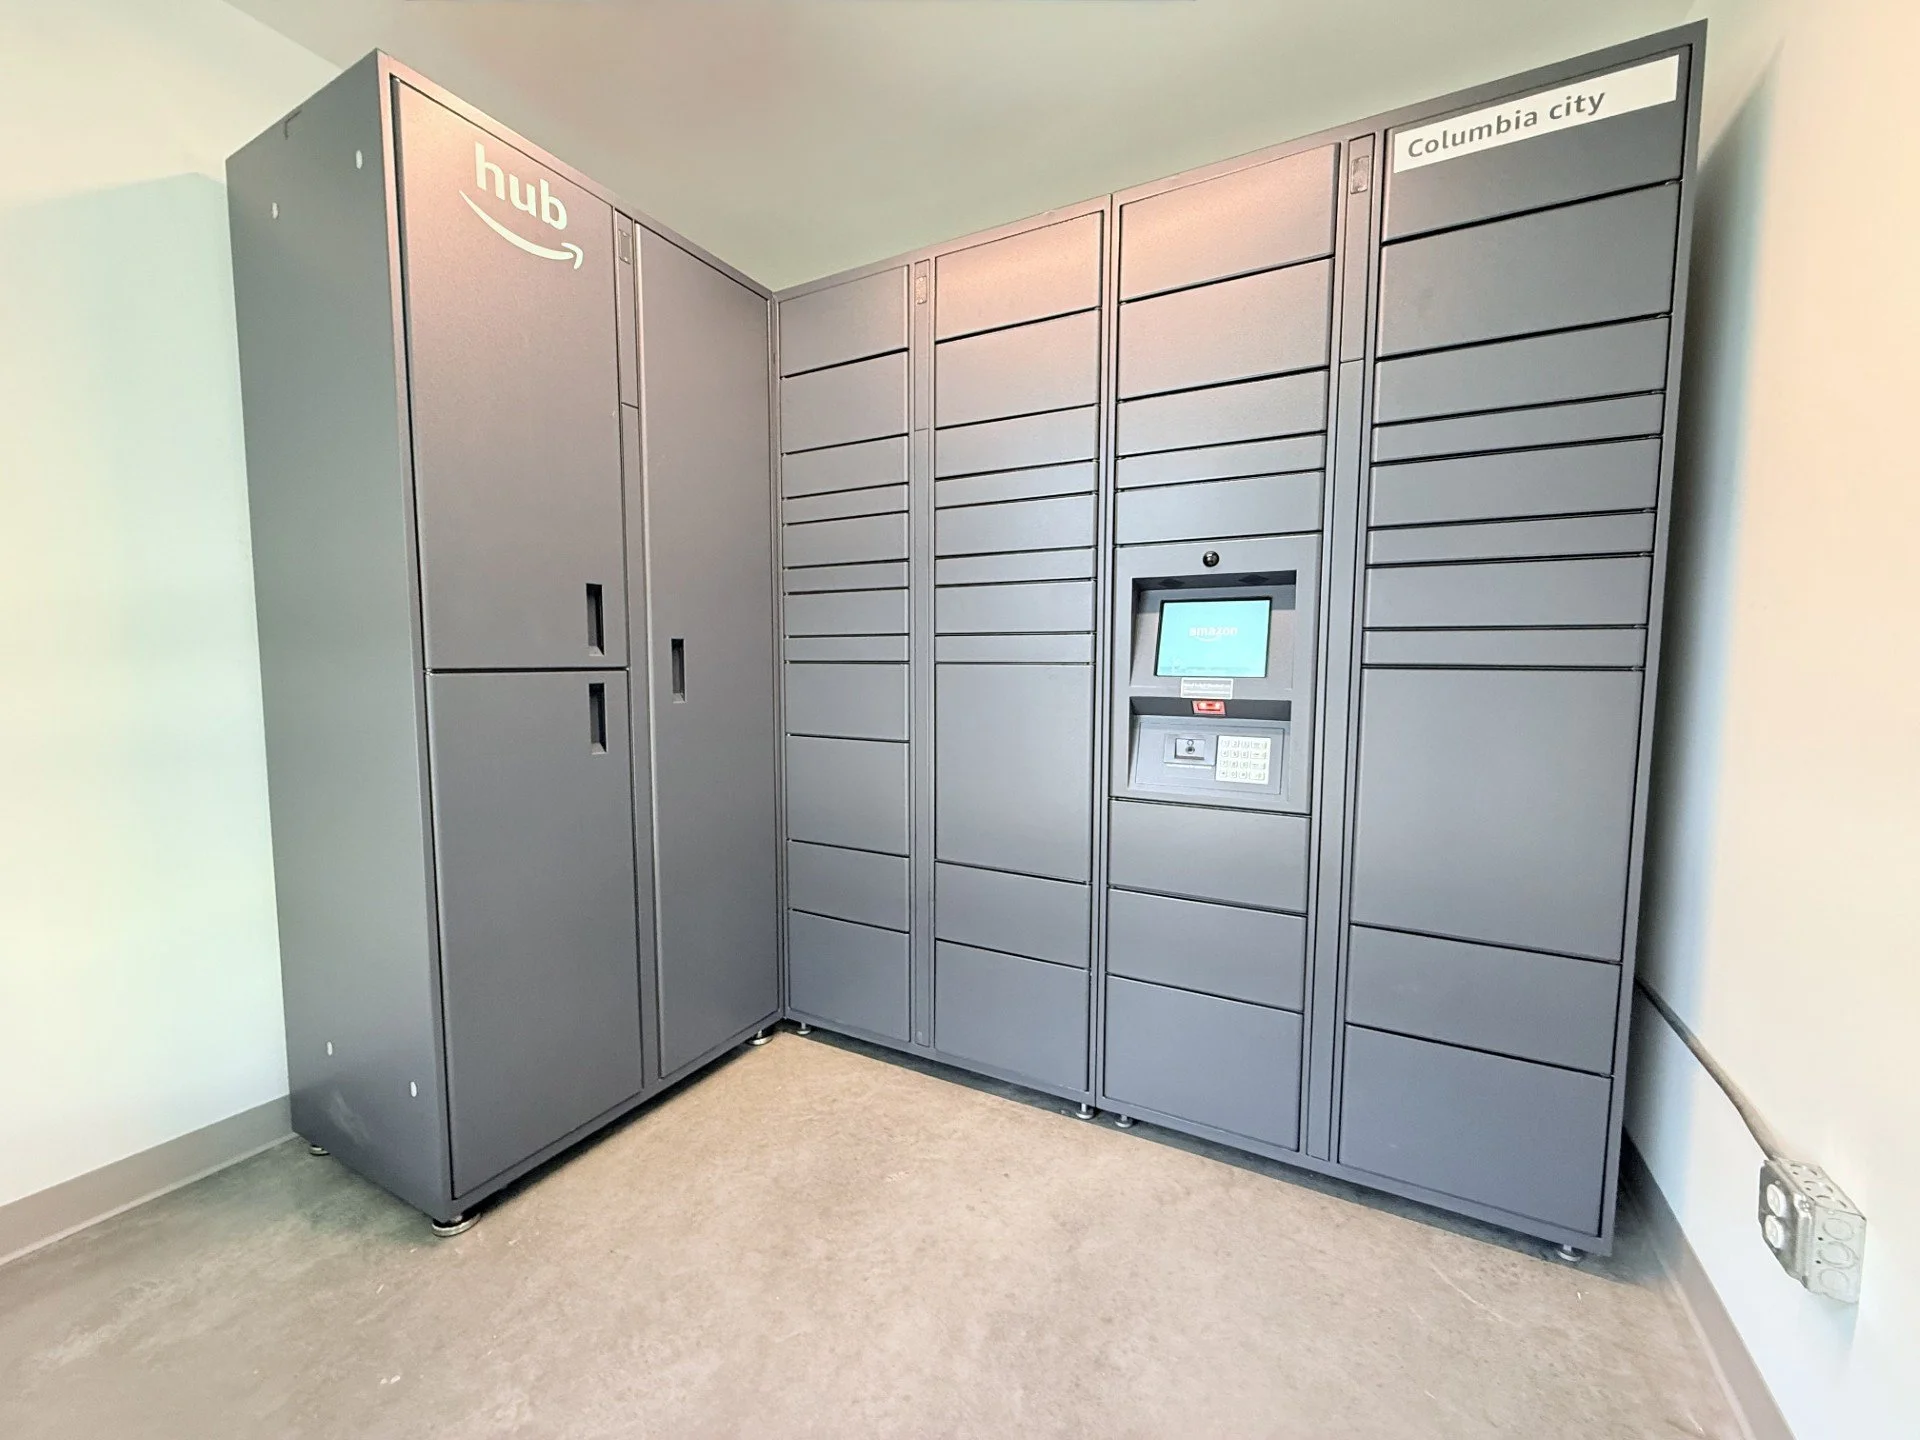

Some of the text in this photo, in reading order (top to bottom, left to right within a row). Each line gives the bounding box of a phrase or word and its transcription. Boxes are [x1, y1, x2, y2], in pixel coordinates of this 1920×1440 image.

[1408, 92, 1606, 158] Columbia city
[475, 141, 567, 230] hub
[1189, 625, 1238, 638] amazon
